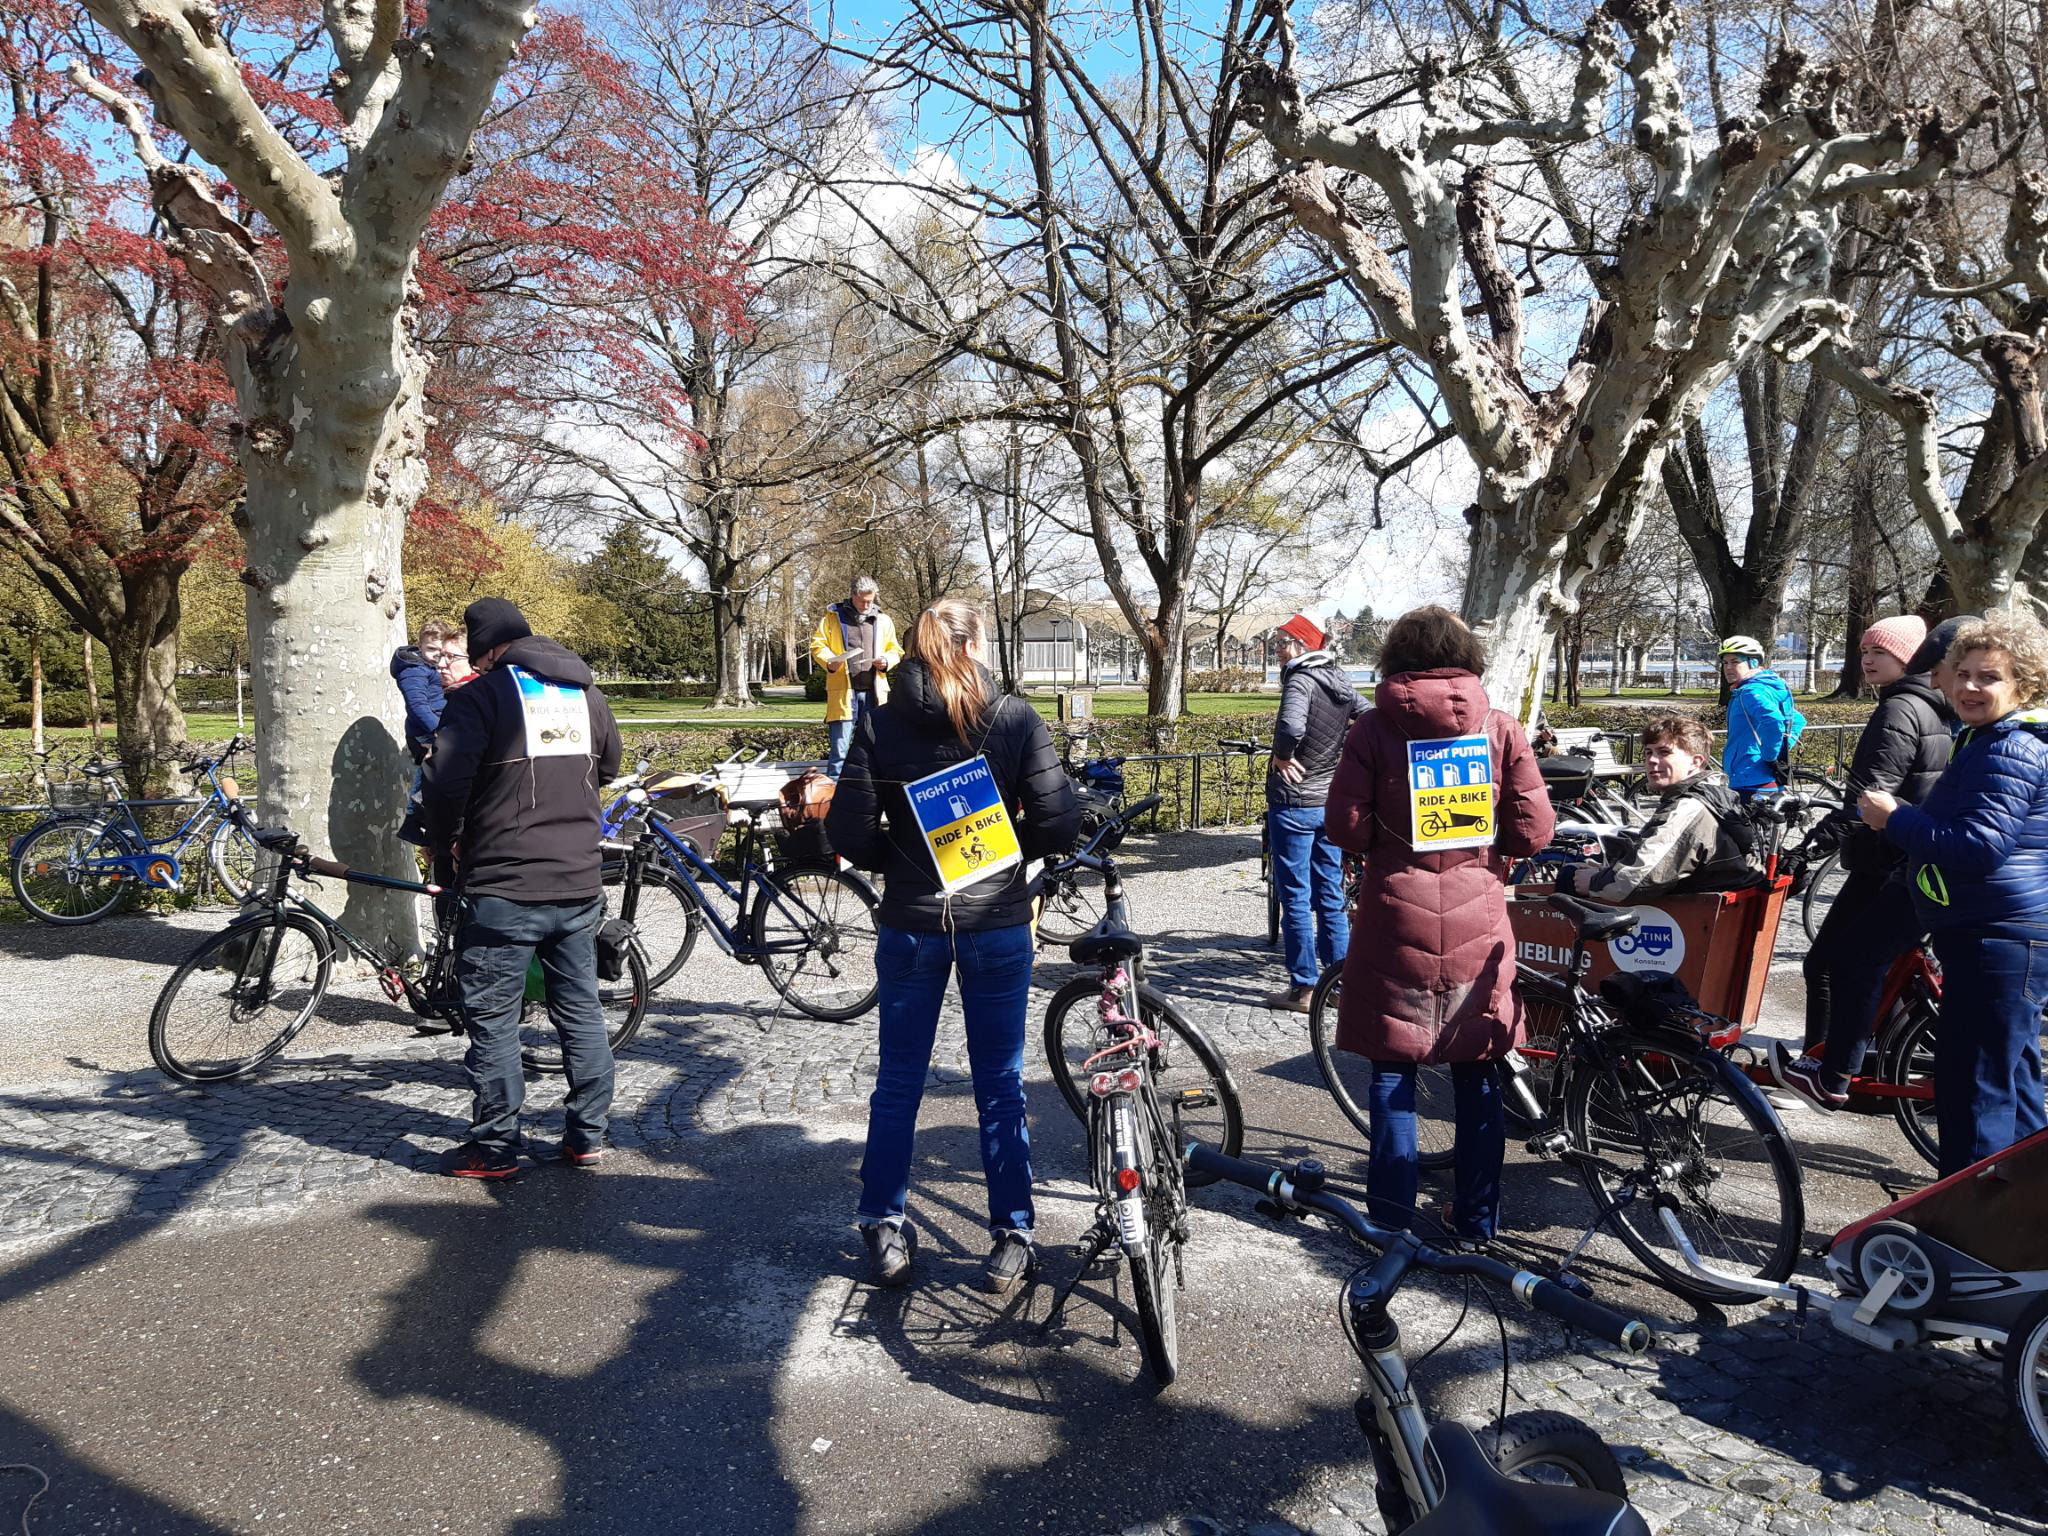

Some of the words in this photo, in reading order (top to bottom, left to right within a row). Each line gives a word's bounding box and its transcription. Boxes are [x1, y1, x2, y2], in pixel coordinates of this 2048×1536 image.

[1415, 748, 1450, 761] FIGHT
[1452, 745, 1487, 758] PUTIN
[915, 781, 951, 803] FIGHT
[951, 766, 989, 789] PUTIN
[1419, 795, 1445, 806] RIDE
[1449, 794, 1457, 804] A
[1460, 791, 1487, 803] BIKE
[934, 828, 962, 848] RIDE
[965, 825, 974, 836] A
[976, 811, 1003, 831] BIKE
[1643, 932, 1671, 943] TINK
[1515, 941, 1592, 969] IEBLING
[1634, 957, 1666, 966] Konstanz
